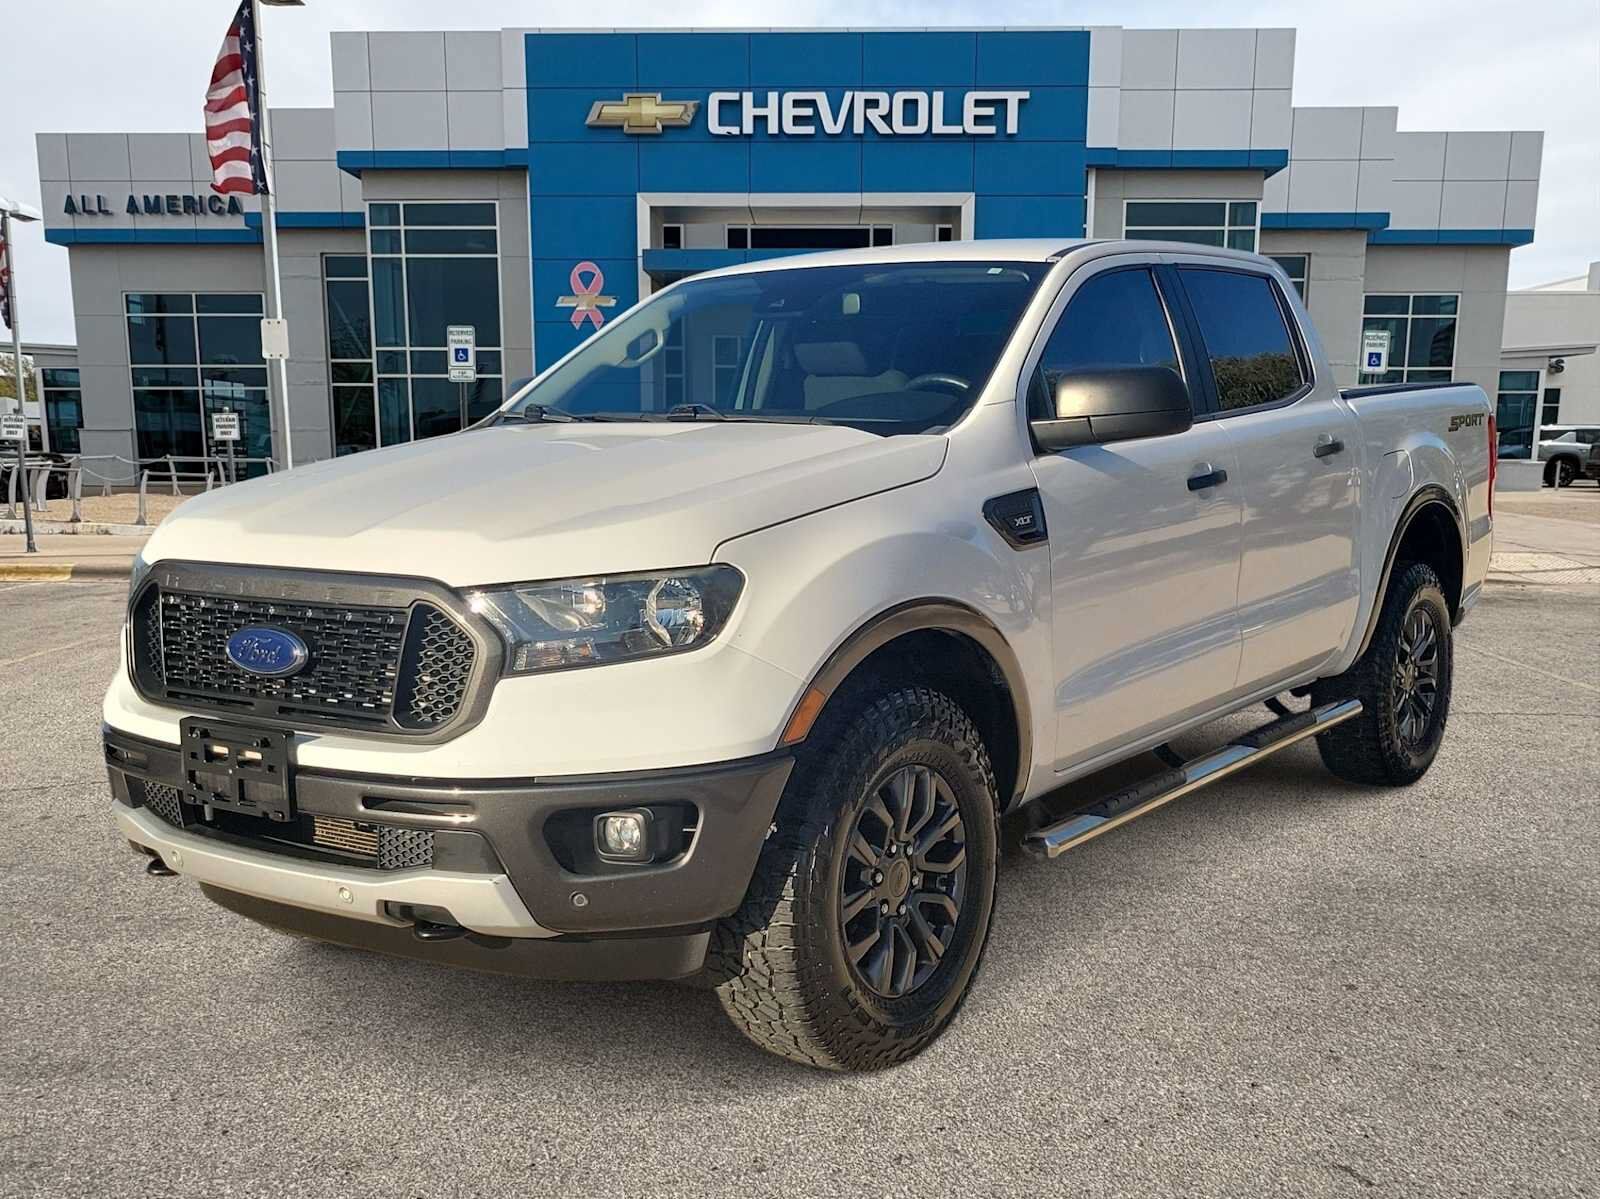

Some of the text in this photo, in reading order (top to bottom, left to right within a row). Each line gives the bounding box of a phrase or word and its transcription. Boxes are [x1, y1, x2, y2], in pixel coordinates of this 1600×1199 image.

[707, 90, 1030, 136] CHEVROLET
[64, 194, 112, 215] ALL
[1448, 413, 1485, 432] SPORT
[1014, 515, 1033, 527] XLT
[239, 636, 283, 664] Ford
